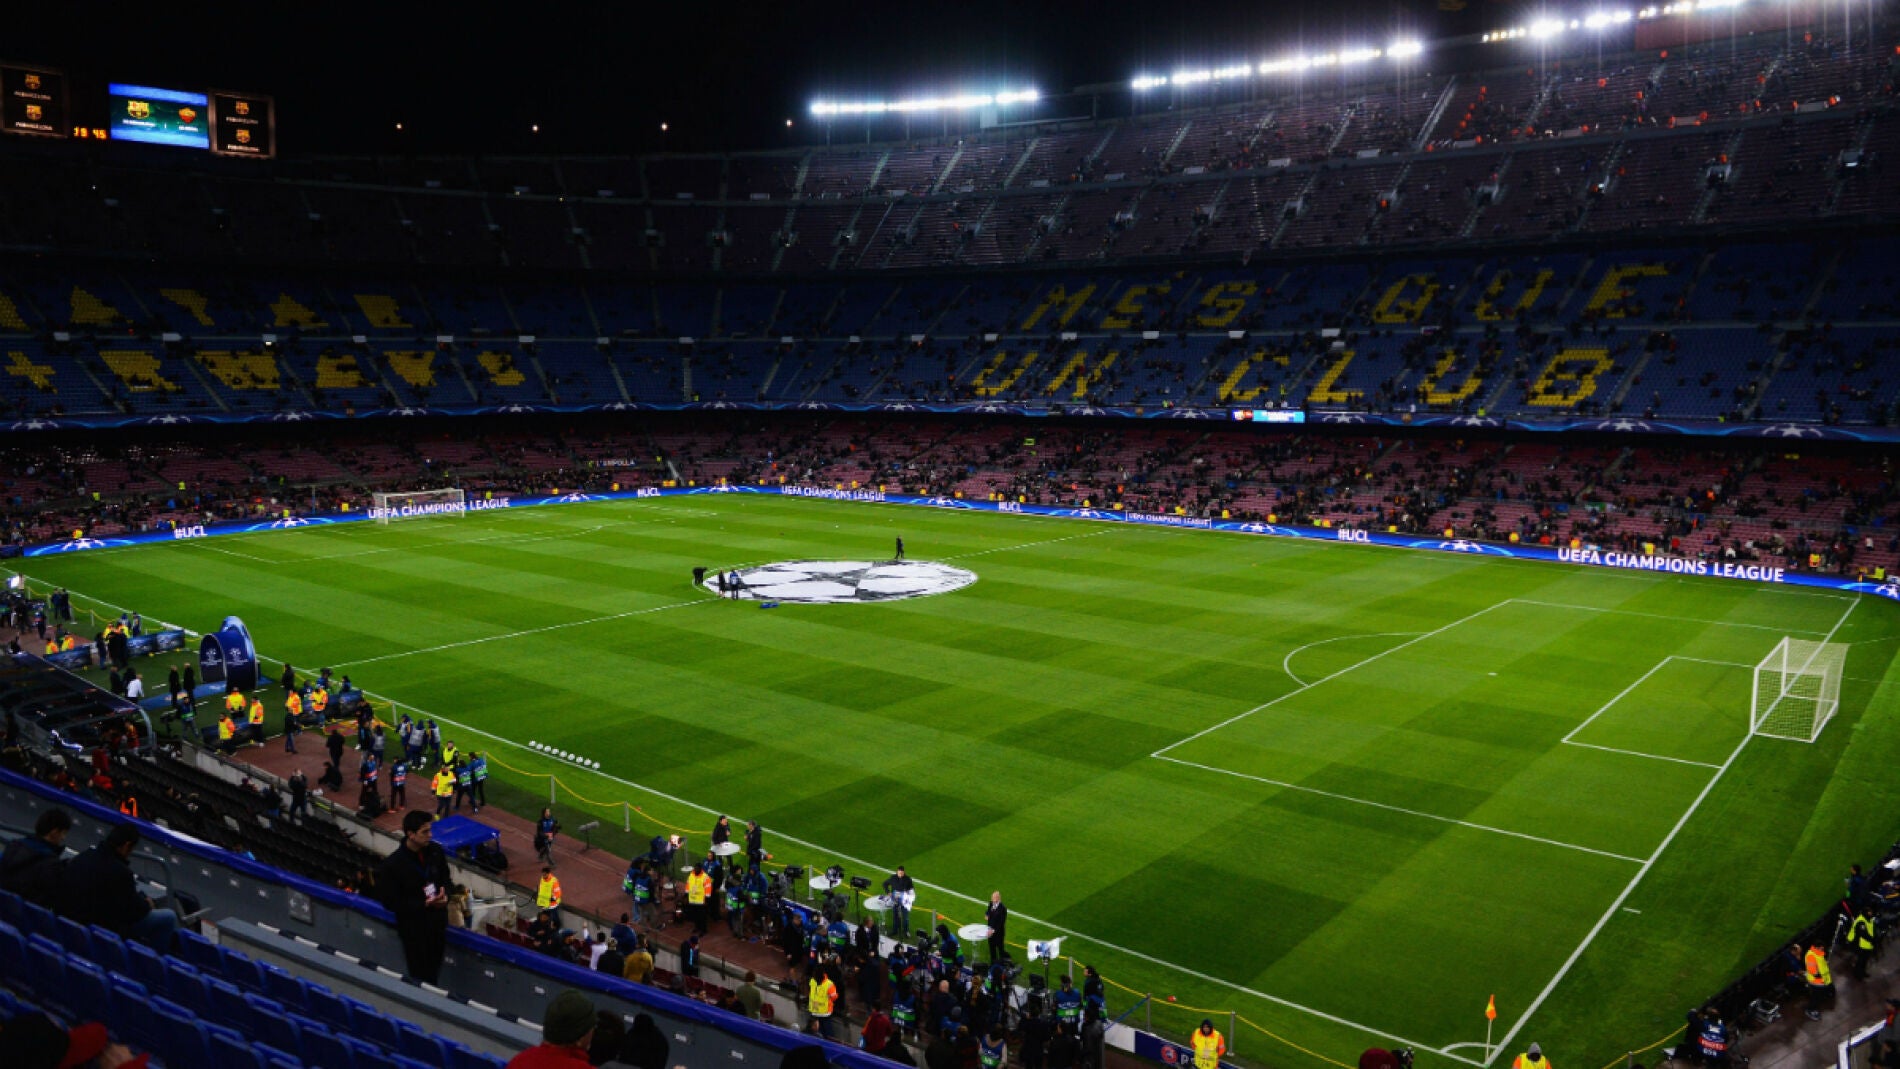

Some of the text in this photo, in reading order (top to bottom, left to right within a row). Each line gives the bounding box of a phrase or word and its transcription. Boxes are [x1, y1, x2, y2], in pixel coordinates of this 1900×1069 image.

[970, 347, 1616, 407] UN CLUB
[781, 485, 886, 501] UEFA CHAMPIONS LEAGUE
[367, 496, 510, 519] UEFA CHAMPIONS LEAGUE
[174, 525, 208, 539] #UCL
[1337, 528, 1372, 543] #UCL
[1557, 547, 1785, 582] UEFA CHAMPIONS LEAGUE
